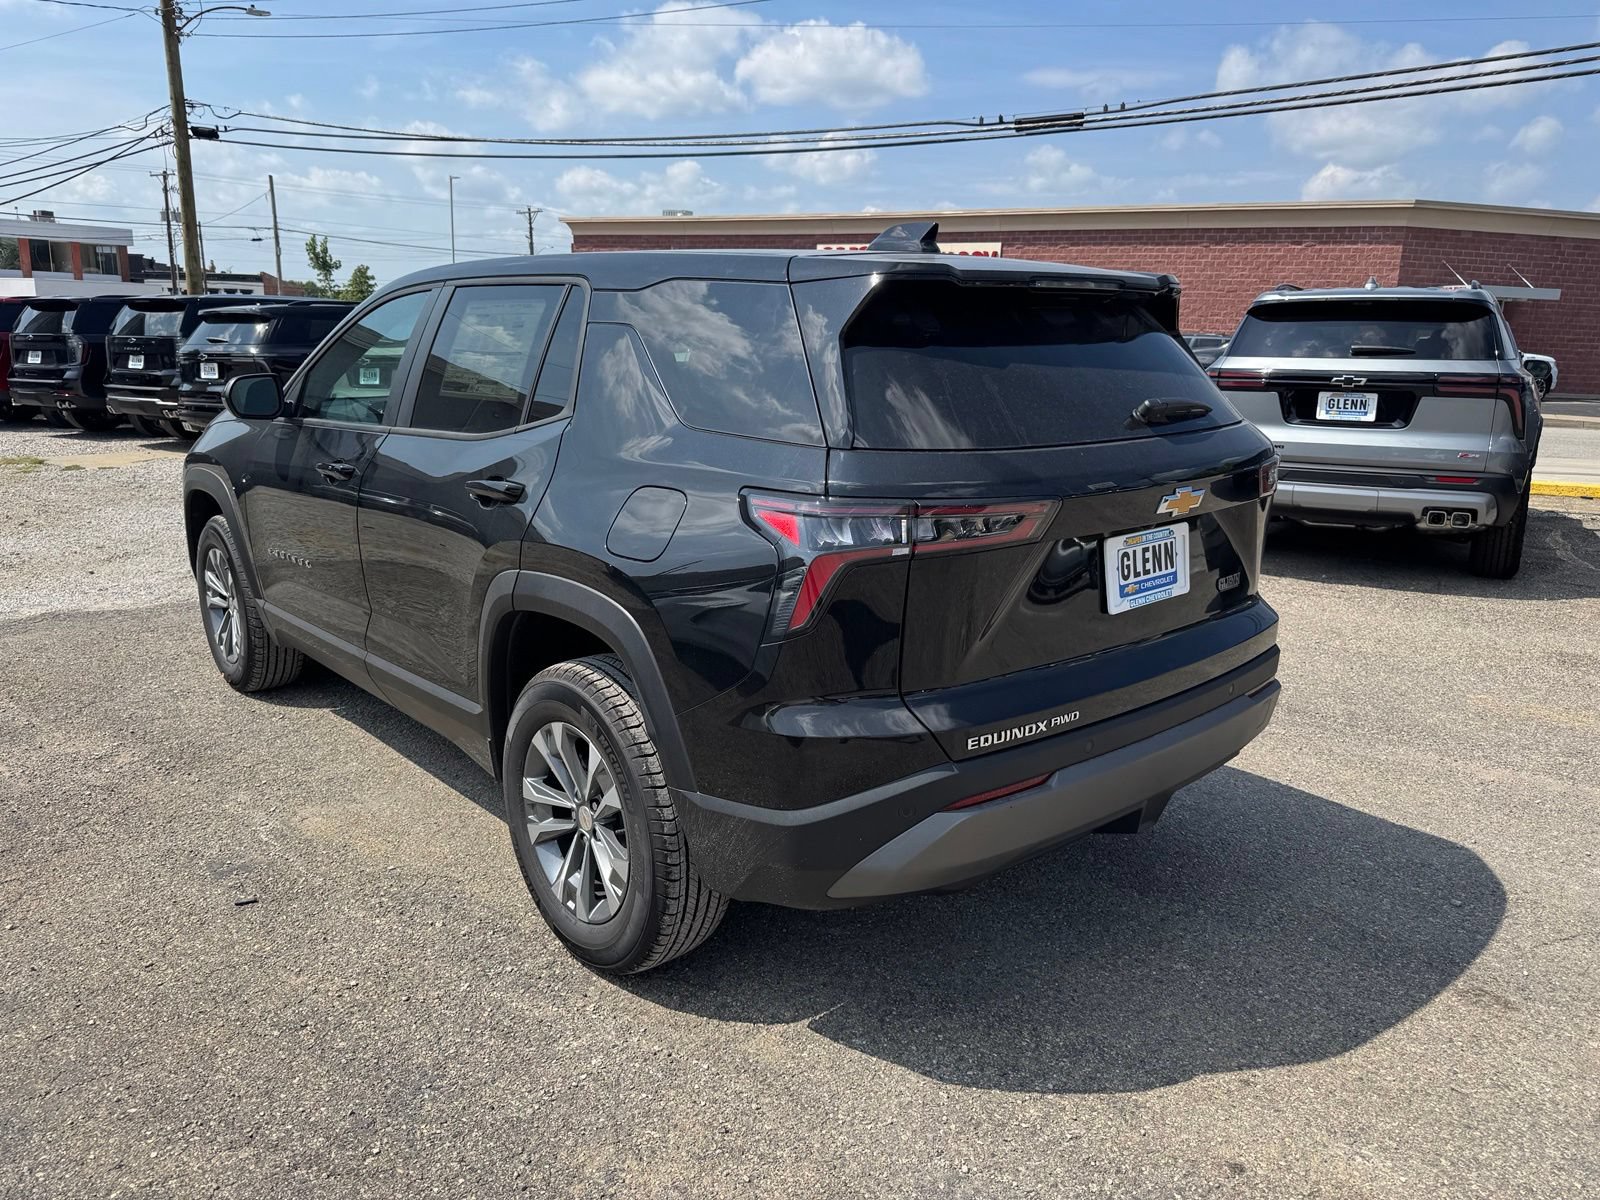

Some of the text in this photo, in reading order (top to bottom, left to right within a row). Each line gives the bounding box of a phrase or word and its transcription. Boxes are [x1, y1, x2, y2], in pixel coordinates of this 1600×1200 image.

[1328, 398, 1368, 411] GLENN
[1120, 541, 1175, 582] GLENN
[1140, 575, 1174, 590] CHEVROLET
[1130, 589, 1173, 608] GLENN CHEVROLET
[967, 711, 1080, 751] EQUINOX AWD
